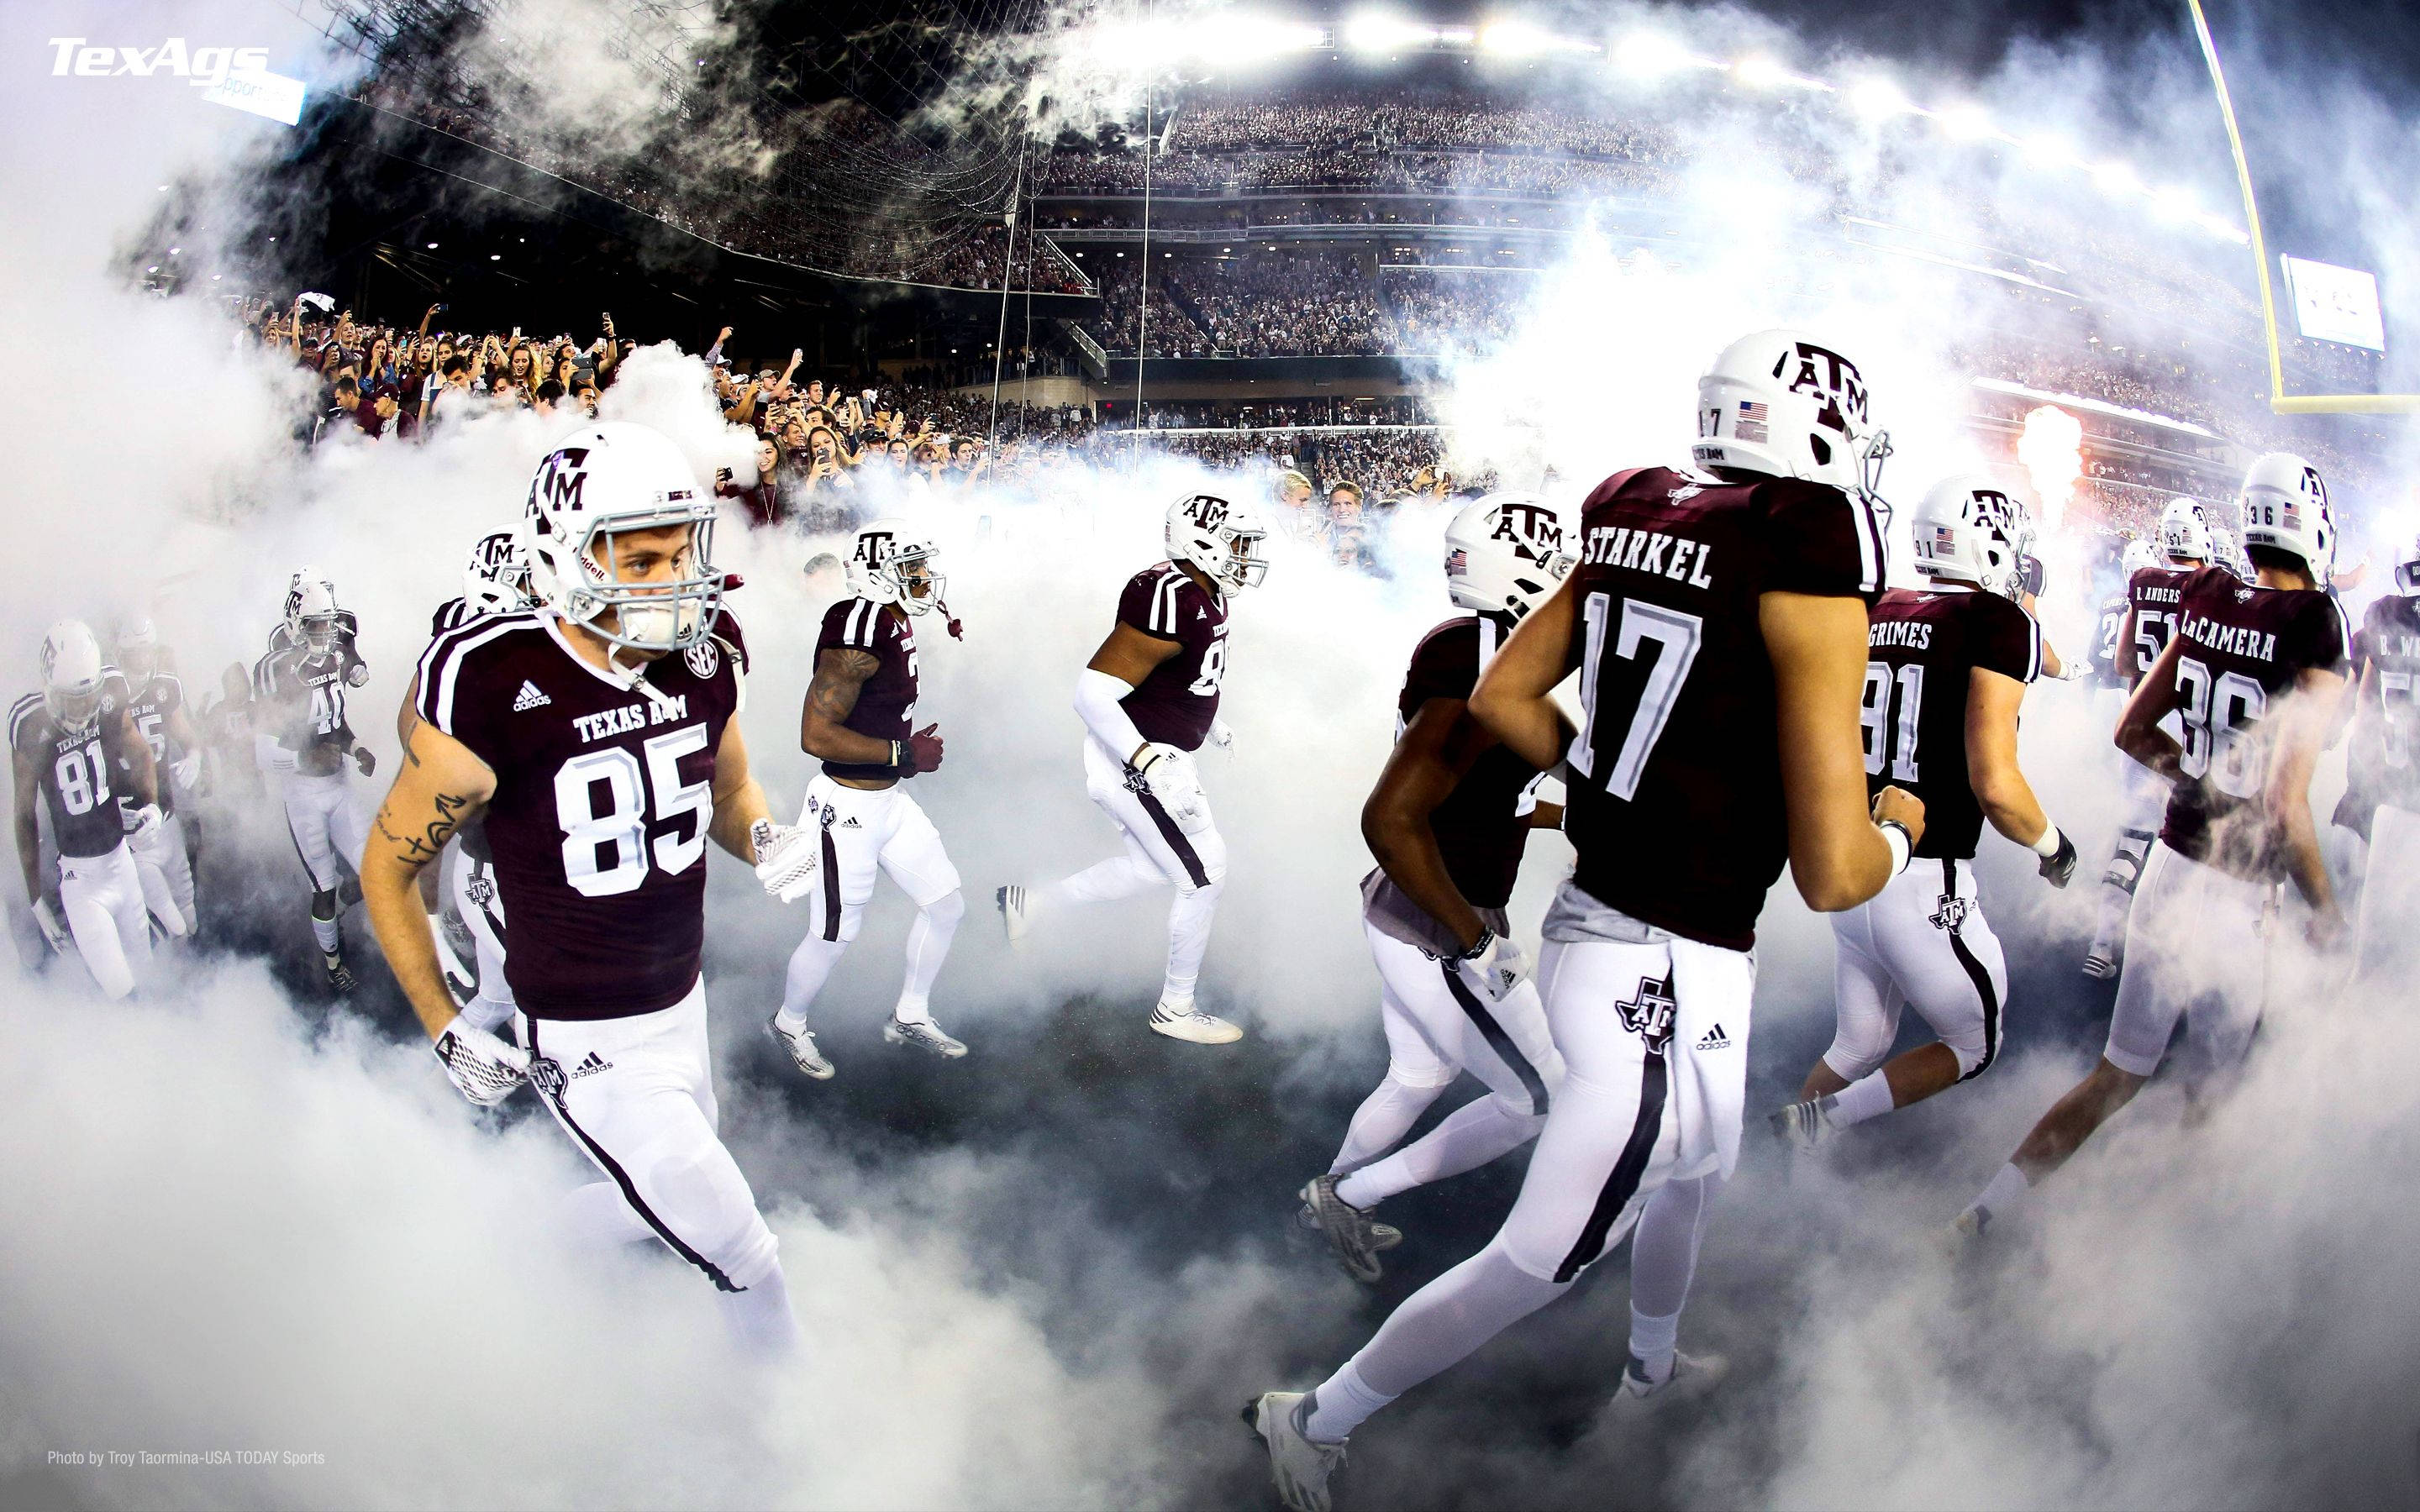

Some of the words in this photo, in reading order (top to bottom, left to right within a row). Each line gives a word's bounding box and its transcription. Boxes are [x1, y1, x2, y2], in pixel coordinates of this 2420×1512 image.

[2251, 505, 2273, 525] 36
[1584, 527, 1712, 589] STARKEL
[2170, 536, 2181, 545] 51
[687, 641, 716, 675] SEC
[1868, 622, 1933, 650] GRIMES
[308, 680, 345, 735] 40
[513, 694, 551, 712] adidas
[1567, 591, 1703, 802] 17
[573, 704, 645, 743] TEXAS
[1860, 661, 1924, 783] 91
[2175, 655, 2267, 799] 36
[55, 739, 110, 815] 81
[554, 722, 714, 896] 85
[571, 1062, 613, 1079] adidas
